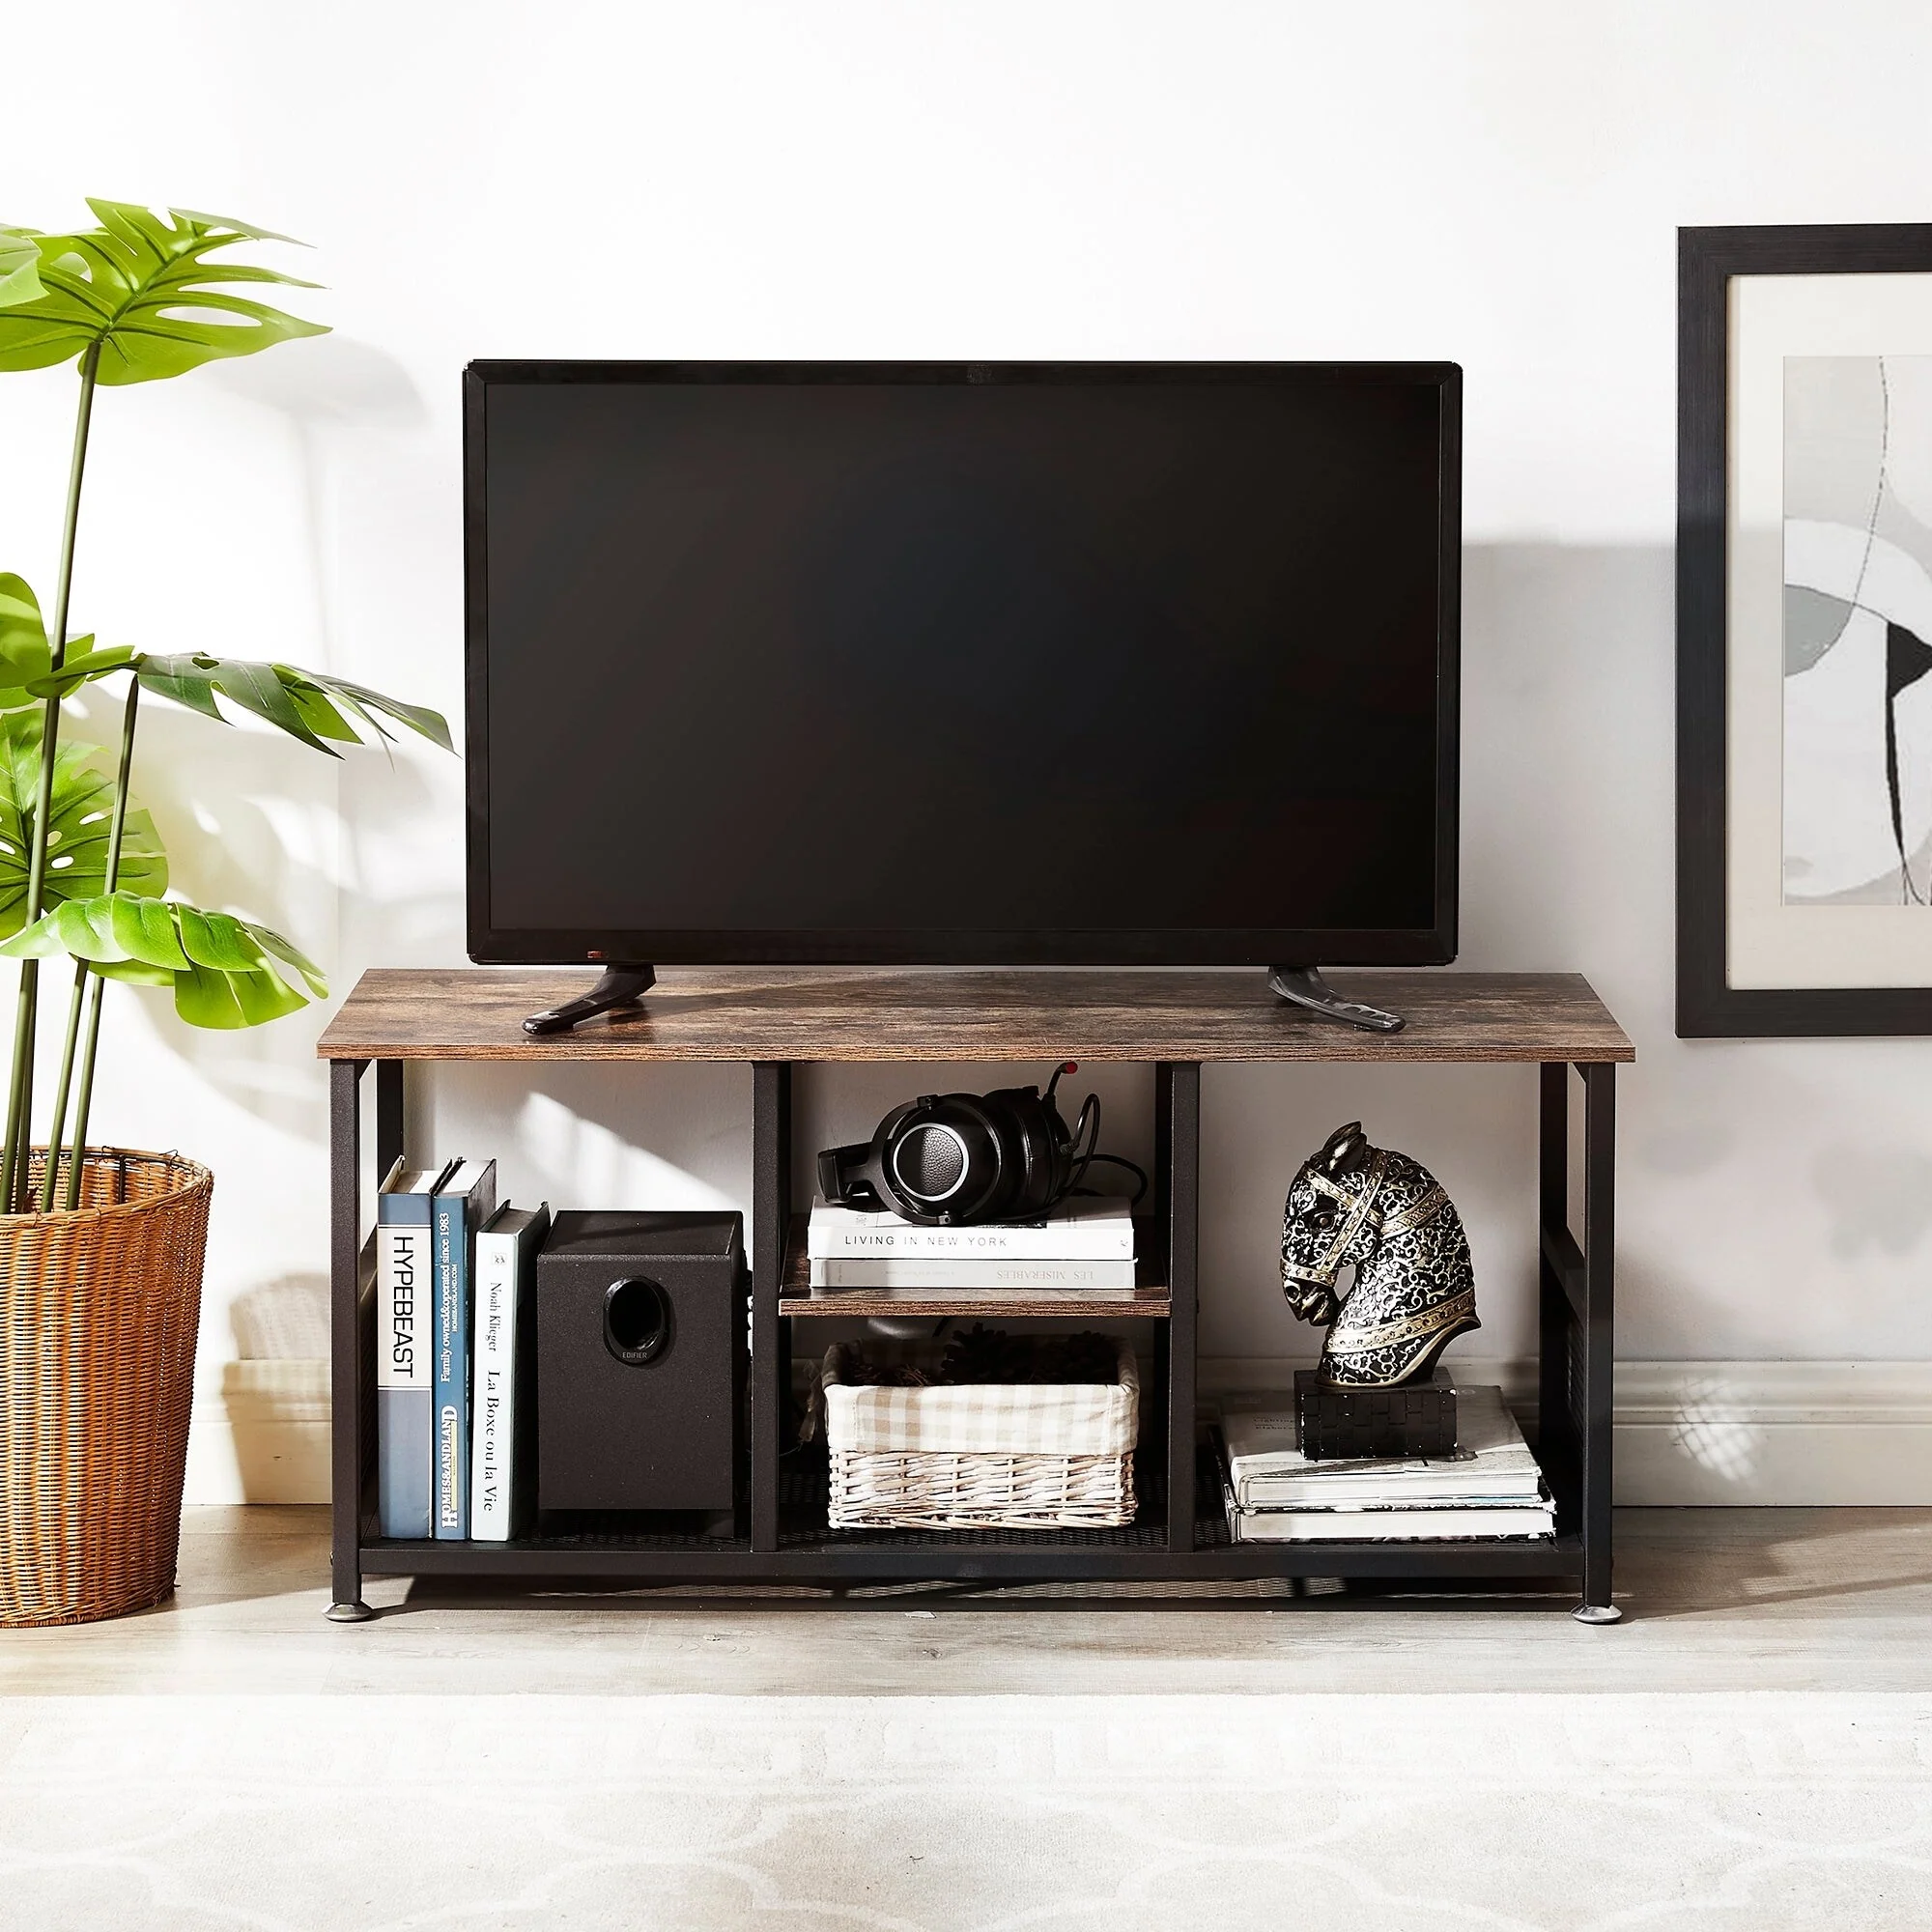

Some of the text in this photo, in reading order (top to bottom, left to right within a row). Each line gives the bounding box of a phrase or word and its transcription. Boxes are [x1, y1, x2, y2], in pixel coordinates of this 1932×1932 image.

[439, 1212, 449, 1236] 1983
[440, 1238, 450, 1264] since
[845, 1236, 1007, 1247] LIVING IN NEW YORK
[1073, 1270, 1094, 1280] LES
[393, 1236, 413, 1378] HYPEBEAST
[485, 1283, 501, 1351] Noah Klieger
[440, 1349, 452, 1382] Family
[483, 1371, 500, 1512] La Boxe ou la Vie
